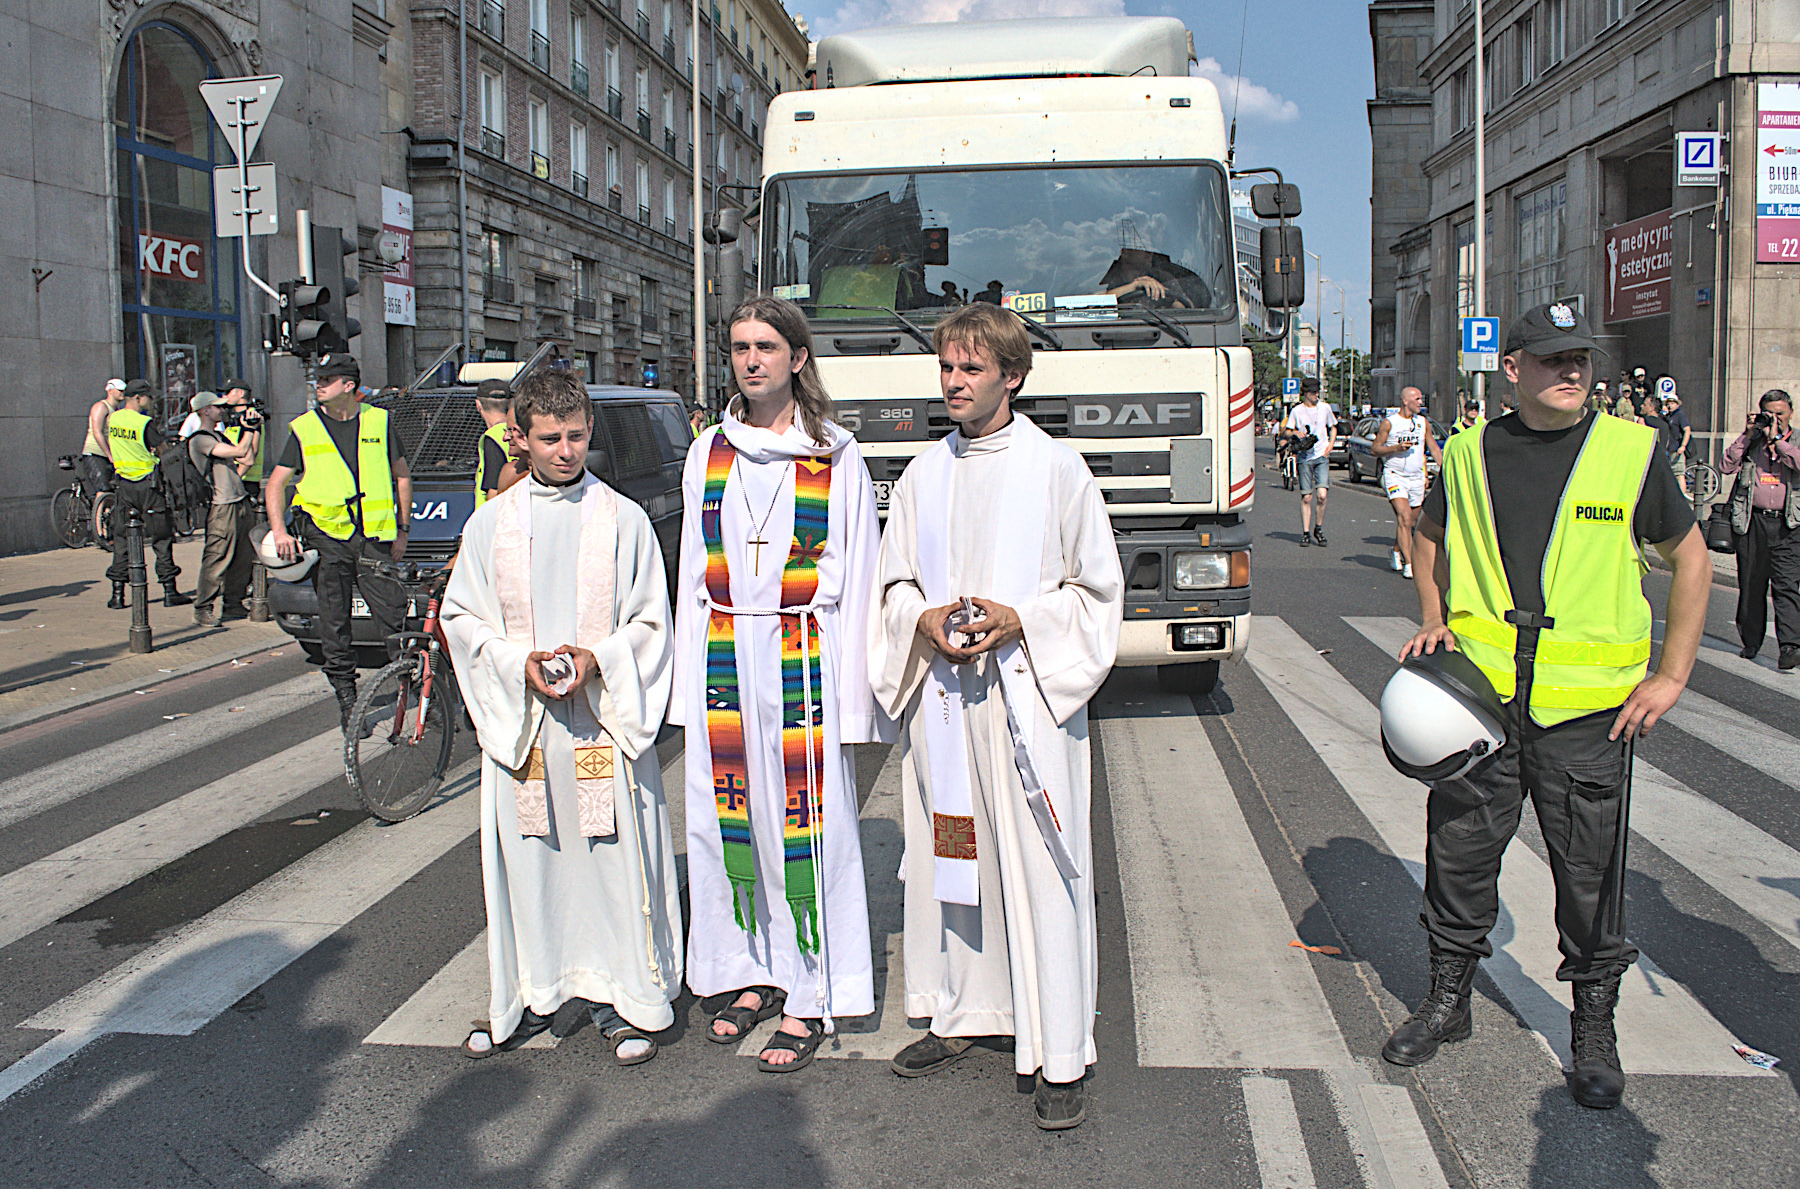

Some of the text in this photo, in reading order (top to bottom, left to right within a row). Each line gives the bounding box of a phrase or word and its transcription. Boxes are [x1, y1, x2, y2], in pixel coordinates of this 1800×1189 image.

[1784, 146, 1798, 155] 50m
[1767, 203, 1777, 215] ul.
[1768, 238, 1799, 257] TEL 22
[139, 234, 200, 279] KFC
[1636, 289, 1658, 300] instytut
[1014, 295, 1044, 311] C16
[1471, 321, 1492, 349] P
[1287, 380, 1297, 393] P
[1664, 382, 1673, 391] P
[880, 408, 913, 419] 360
[1074, 403, 1191, 426] DAF
[894, 421, 914, 431] ATi
[110, 426, 137, 440] POLICJA
[1575, 506, 1624, 521] POLICJA
